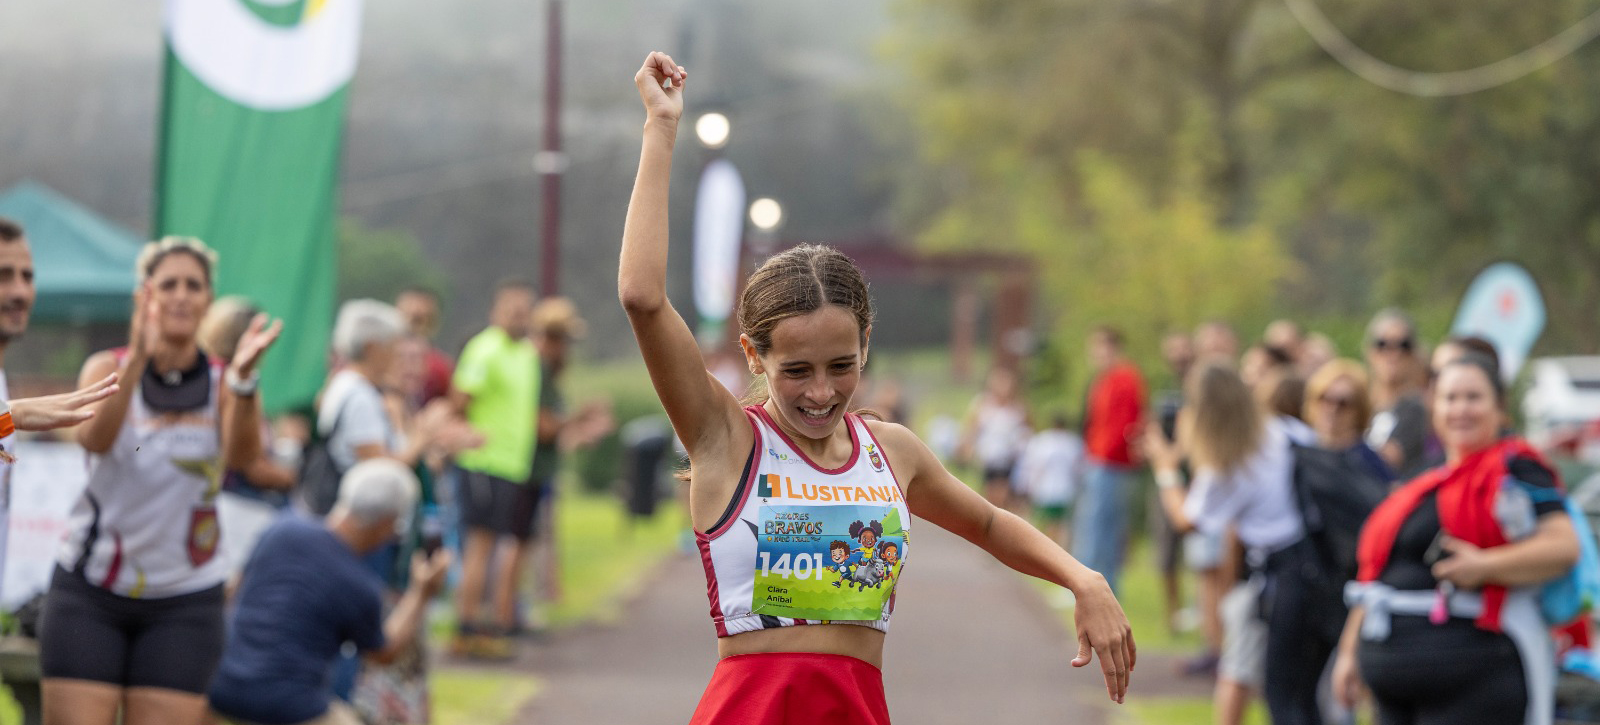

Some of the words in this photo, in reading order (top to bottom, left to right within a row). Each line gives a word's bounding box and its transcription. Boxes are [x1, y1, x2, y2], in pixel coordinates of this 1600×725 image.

[786, 476, 903, 502] LUSITANIA
[765, 520, 823, 535] BRAVOS
[759, 552, 823, 580] 1401
[767, 586, 788, 594] Clara
